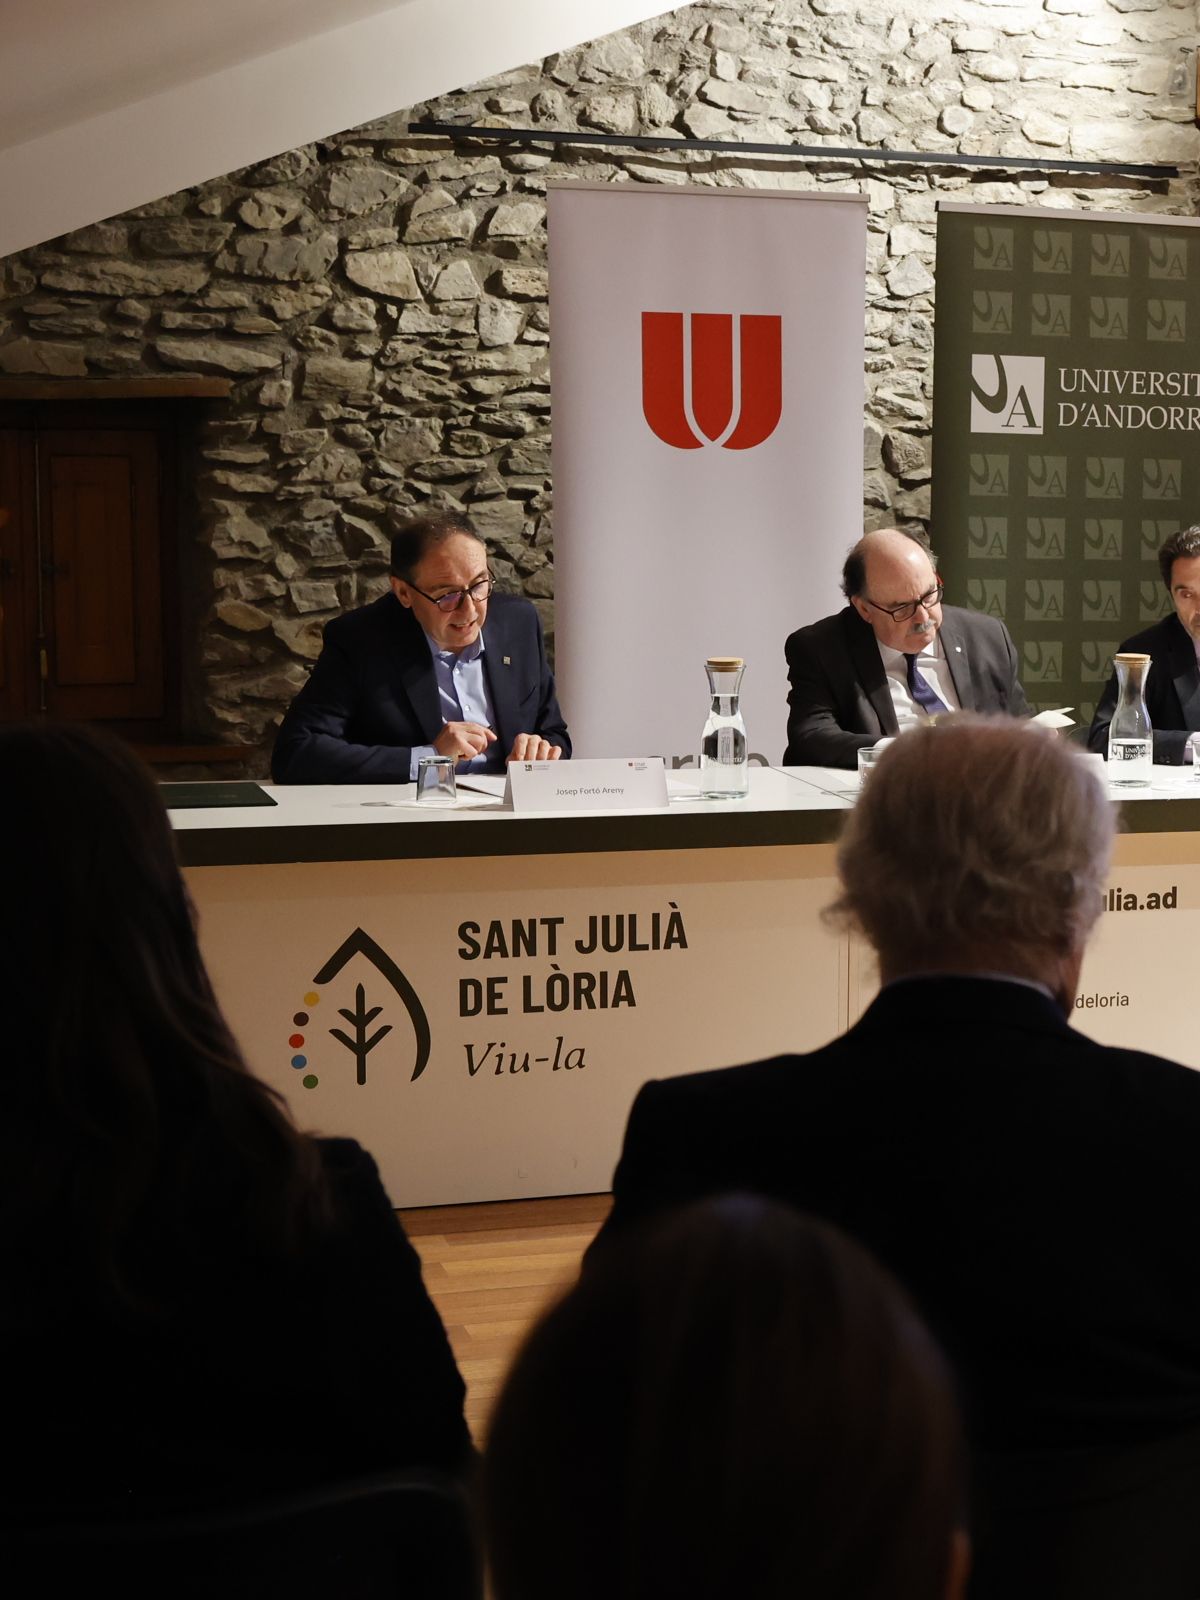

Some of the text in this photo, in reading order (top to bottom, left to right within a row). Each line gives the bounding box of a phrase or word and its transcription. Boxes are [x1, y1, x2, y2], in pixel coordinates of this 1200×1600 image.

[556, 786, 625, 797] Josep Fortó Areny
[1103, 886, 1178, 912] lia.ad
[457, 902, 688, 961] SANT JULIÀ
[459, 963, 637, 1018] DE LÒRIA
[1074, 991, 1129, 1009] deloria
[463, 1035, 587, 1078] Viu-la
